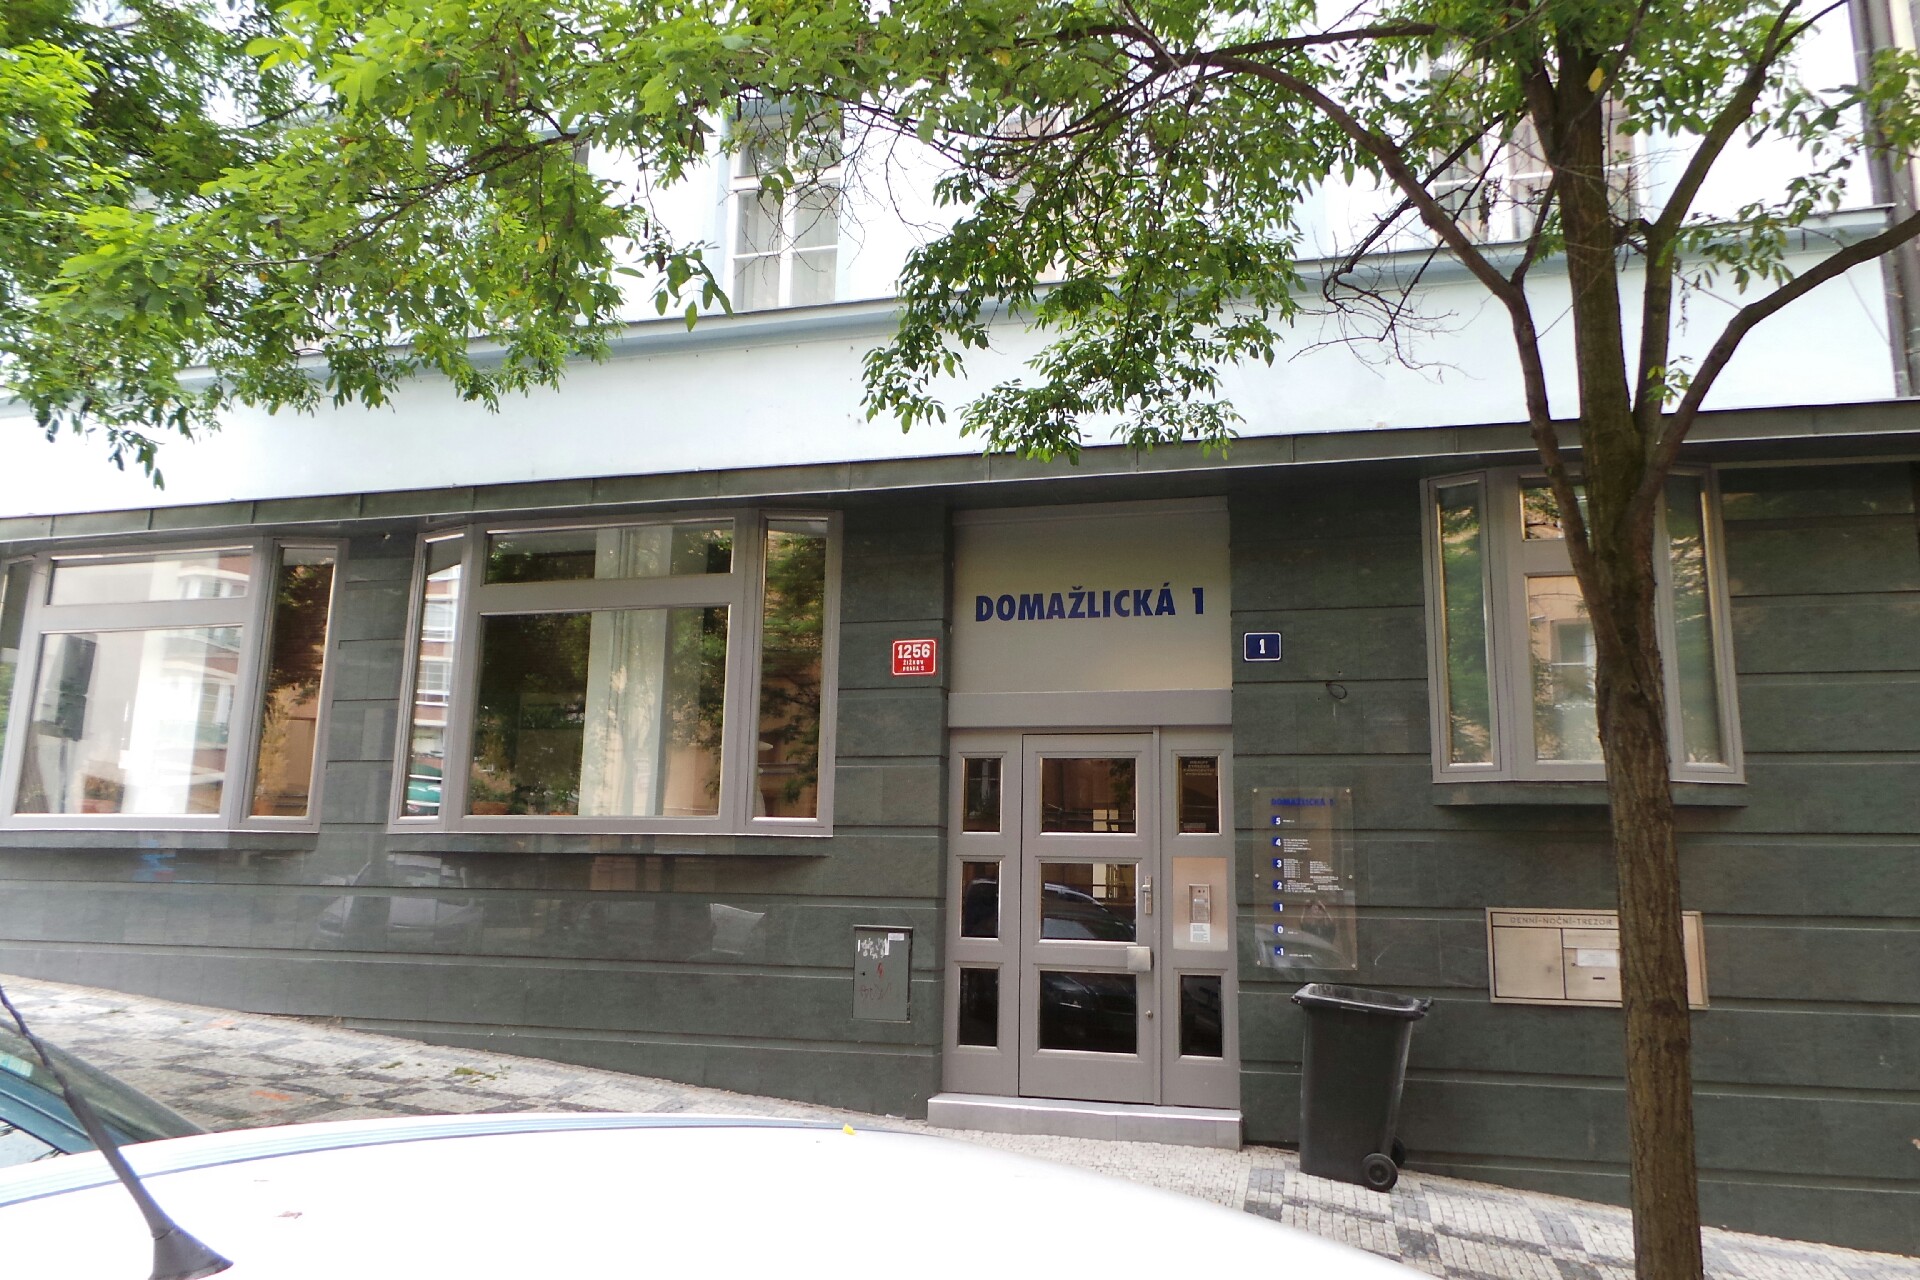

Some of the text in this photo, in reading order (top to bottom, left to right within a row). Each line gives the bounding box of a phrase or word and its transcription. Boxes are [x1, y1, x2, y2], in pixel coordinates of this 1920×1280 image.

[975, 582, 1204, 622] DOMAŽLICKÁ 1
[1259, 638, 1266, 654] 1
[897, 643, 931, 659] 1256
[1275, 817, 1281, 825] 5
[1275, 838, 1281, 847] 4
[1276, 859, 1282, 868] 3
[1277, 881, 1283, 890] 2
[1279, 903, 1284, 912] 1
[1277, 925, 1284, 934] 0
[1276, 947, 1284, 956] -1
